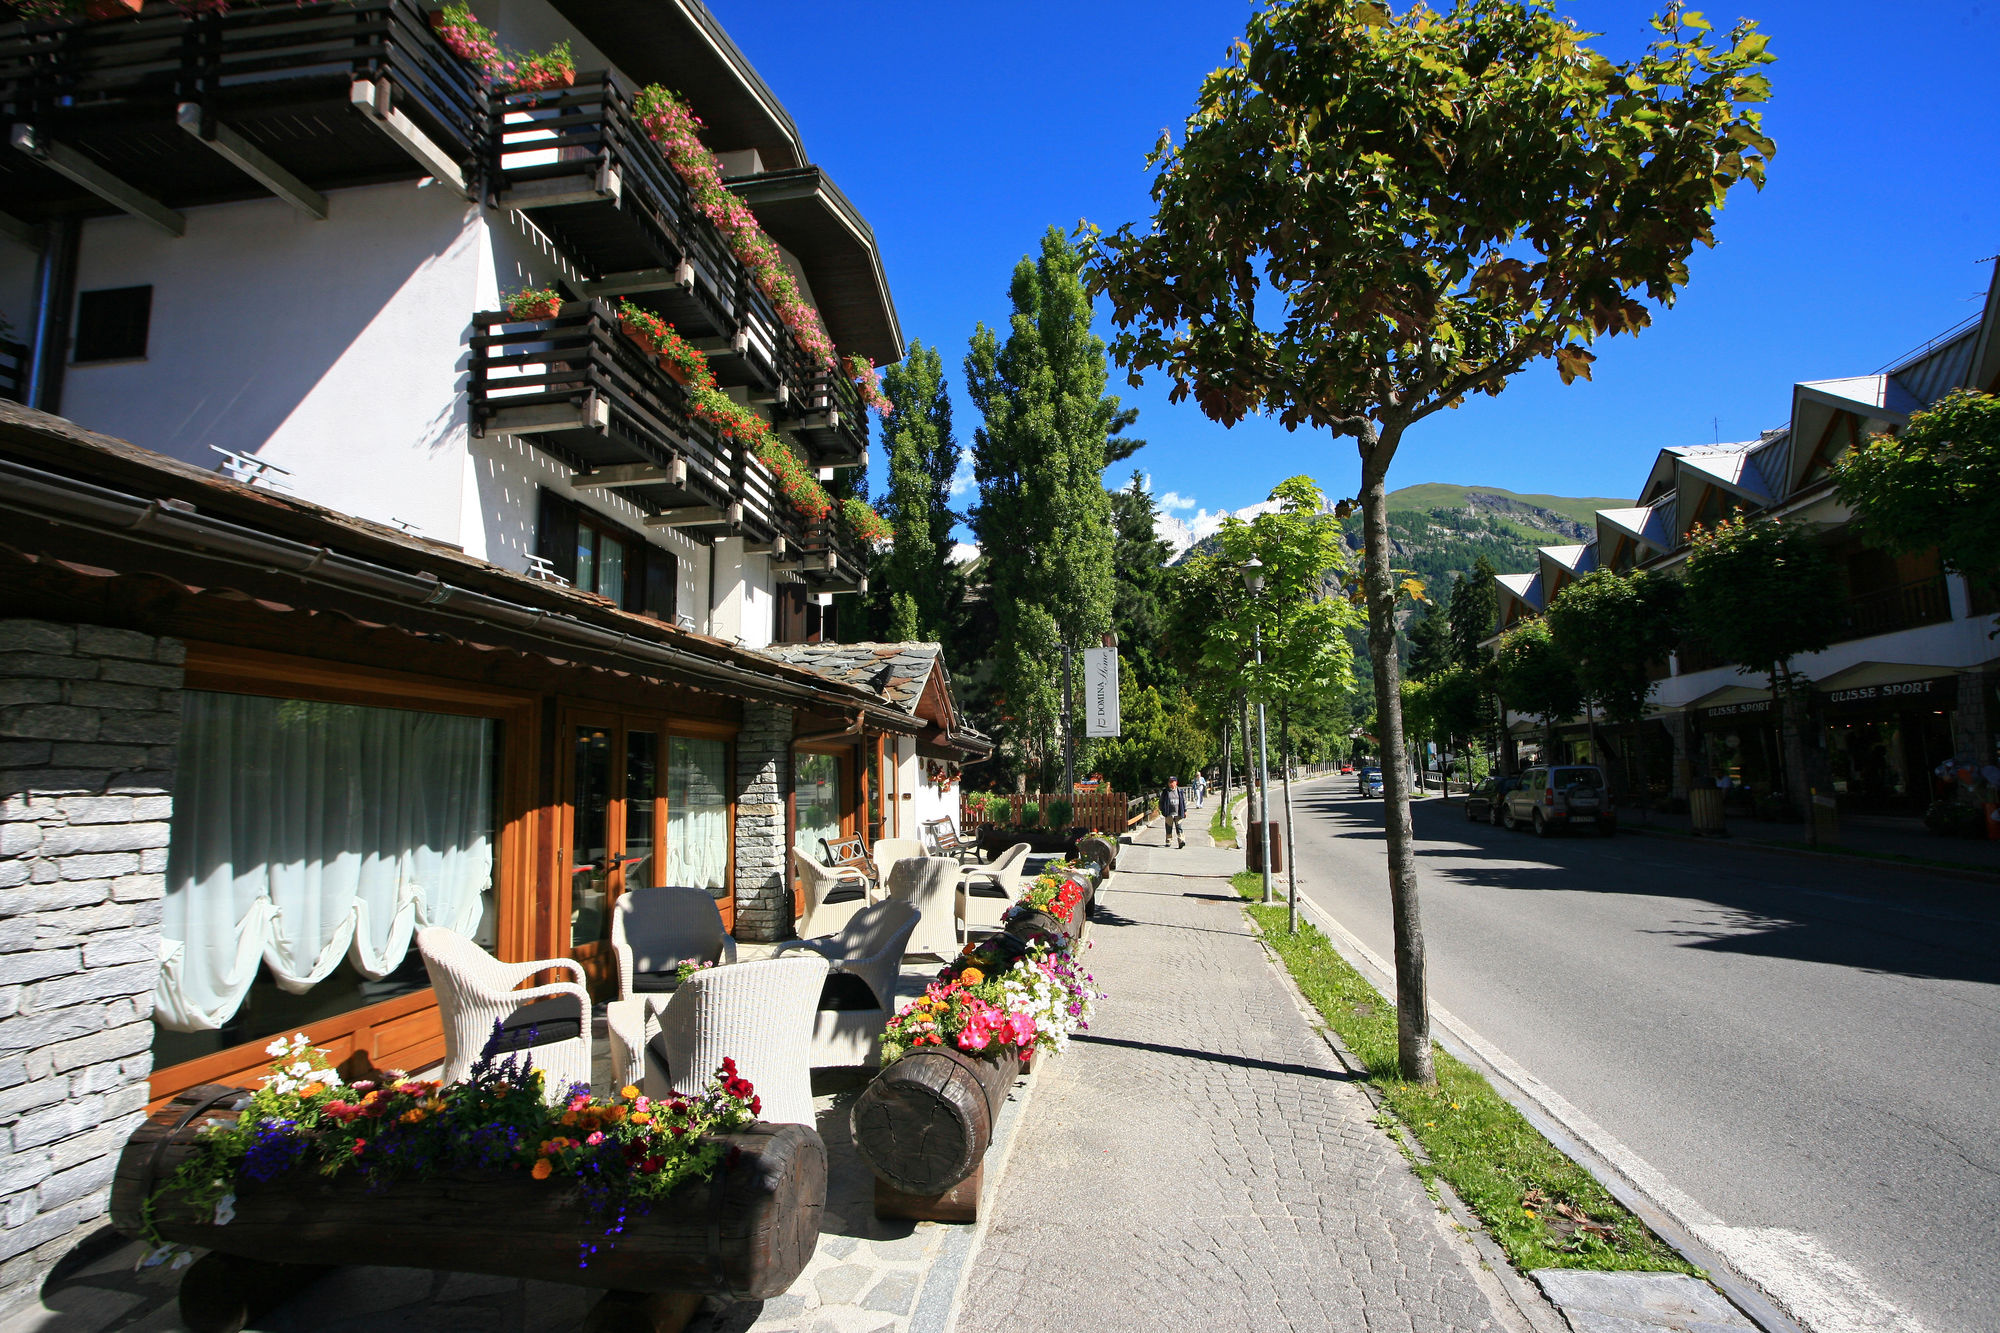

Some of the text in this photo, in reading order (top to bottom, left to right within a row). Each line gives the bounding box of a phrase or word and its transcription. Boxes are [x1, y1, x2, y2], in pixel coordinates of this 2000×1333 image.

[1097, 652, 1109, 716] DOMINA Home
[1830, 680, 1934, 703] ULISSE SPORT
[1708, 701, 1771, 718] ULISSE SPORT
